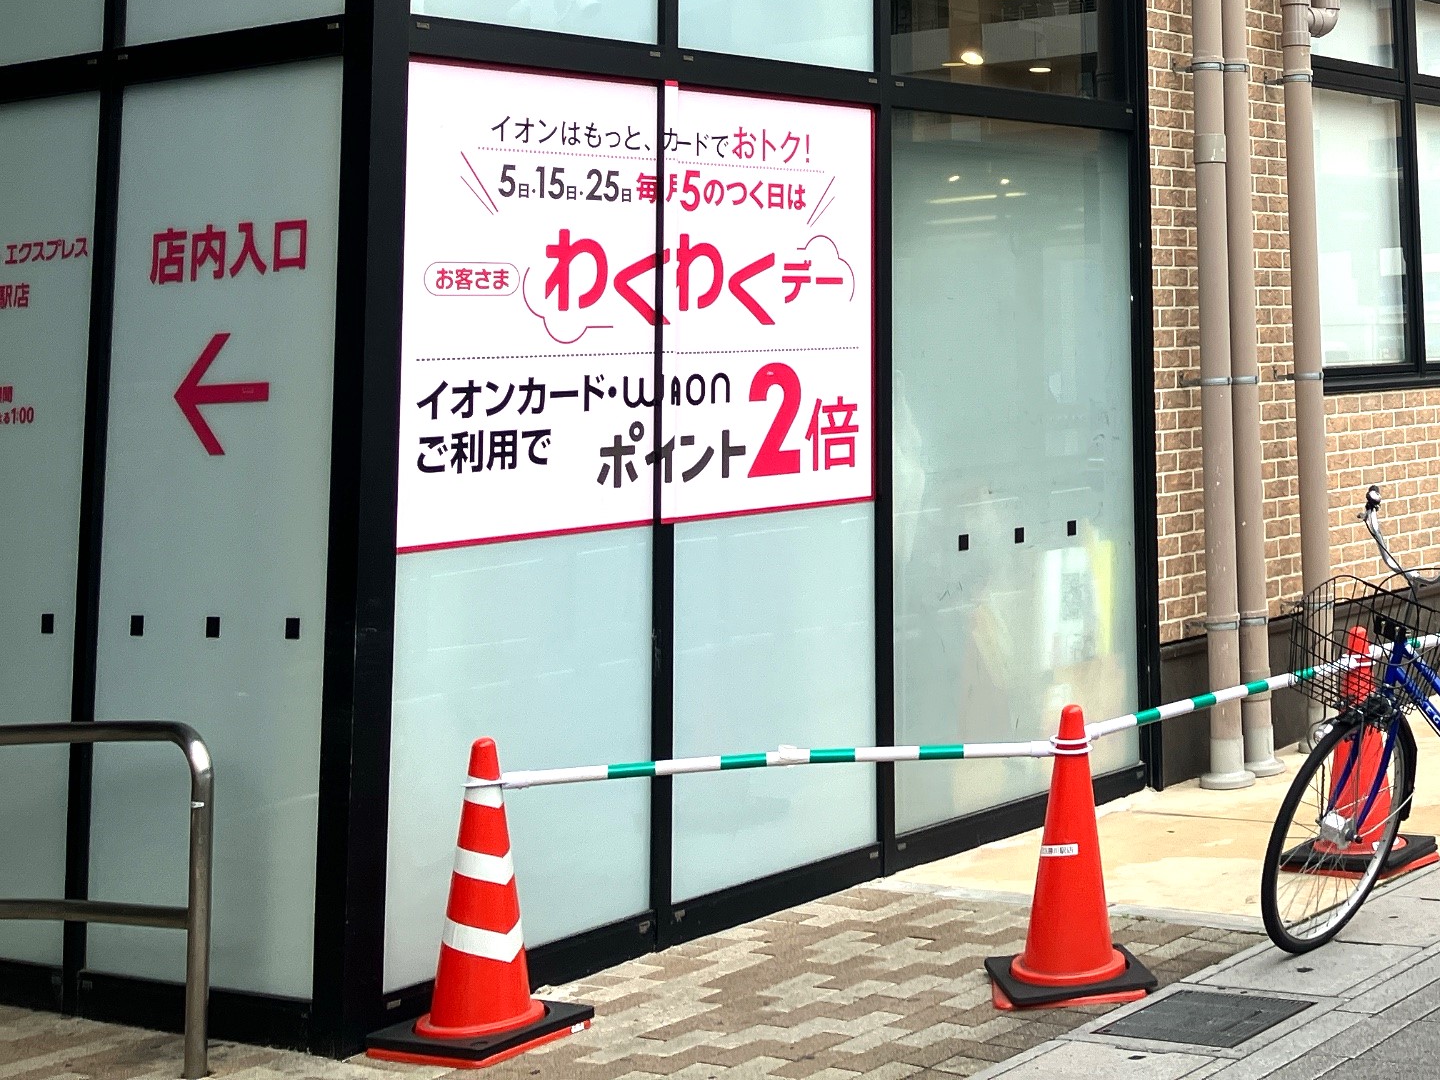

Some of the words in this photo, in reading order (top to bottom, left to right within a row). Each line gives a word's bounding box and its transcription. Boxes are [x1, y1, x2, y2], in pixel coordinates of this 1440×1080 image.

[5, 237, 89, 265] エクスプレス
[149, 219, 308, 286] 店内入口
[435, 267, 510, 291] お客さま
[416, 428, 552, 474] ご利用で
